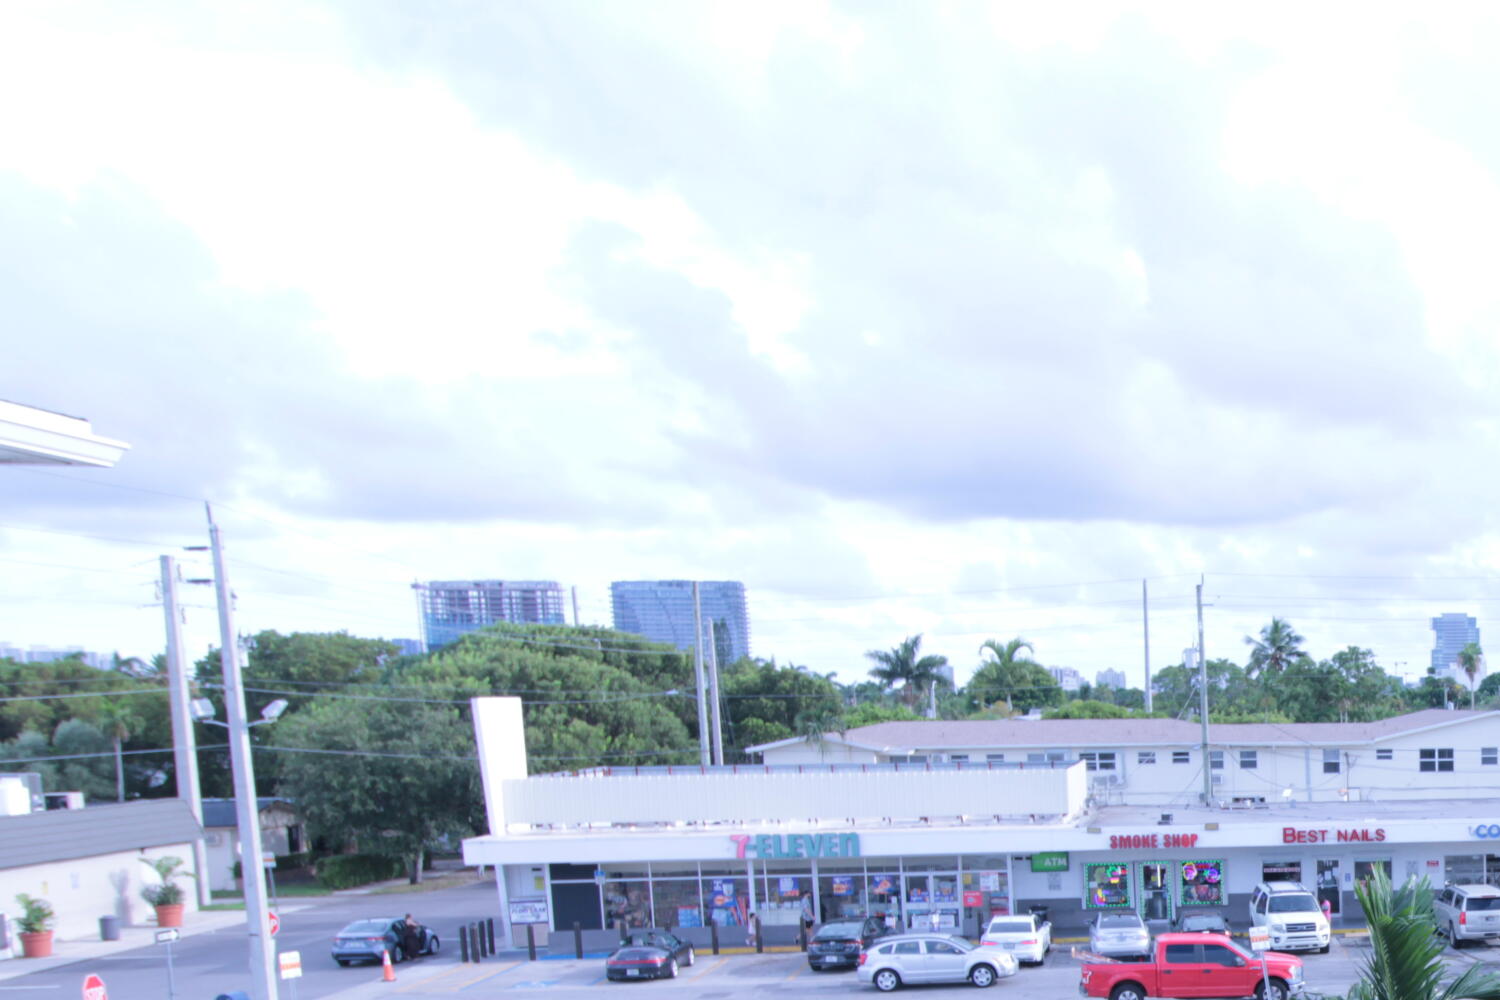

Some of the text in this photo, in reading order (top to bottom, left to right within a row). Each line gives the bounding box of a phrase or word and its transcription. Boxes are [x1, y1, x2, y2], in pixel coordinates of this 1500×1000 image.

[1110, 834, 1198, 849] SMOKE SHOP
[1282, 827, 1386, 843] BEST NAILS
[1044, 857, 1067, 867] ATM
